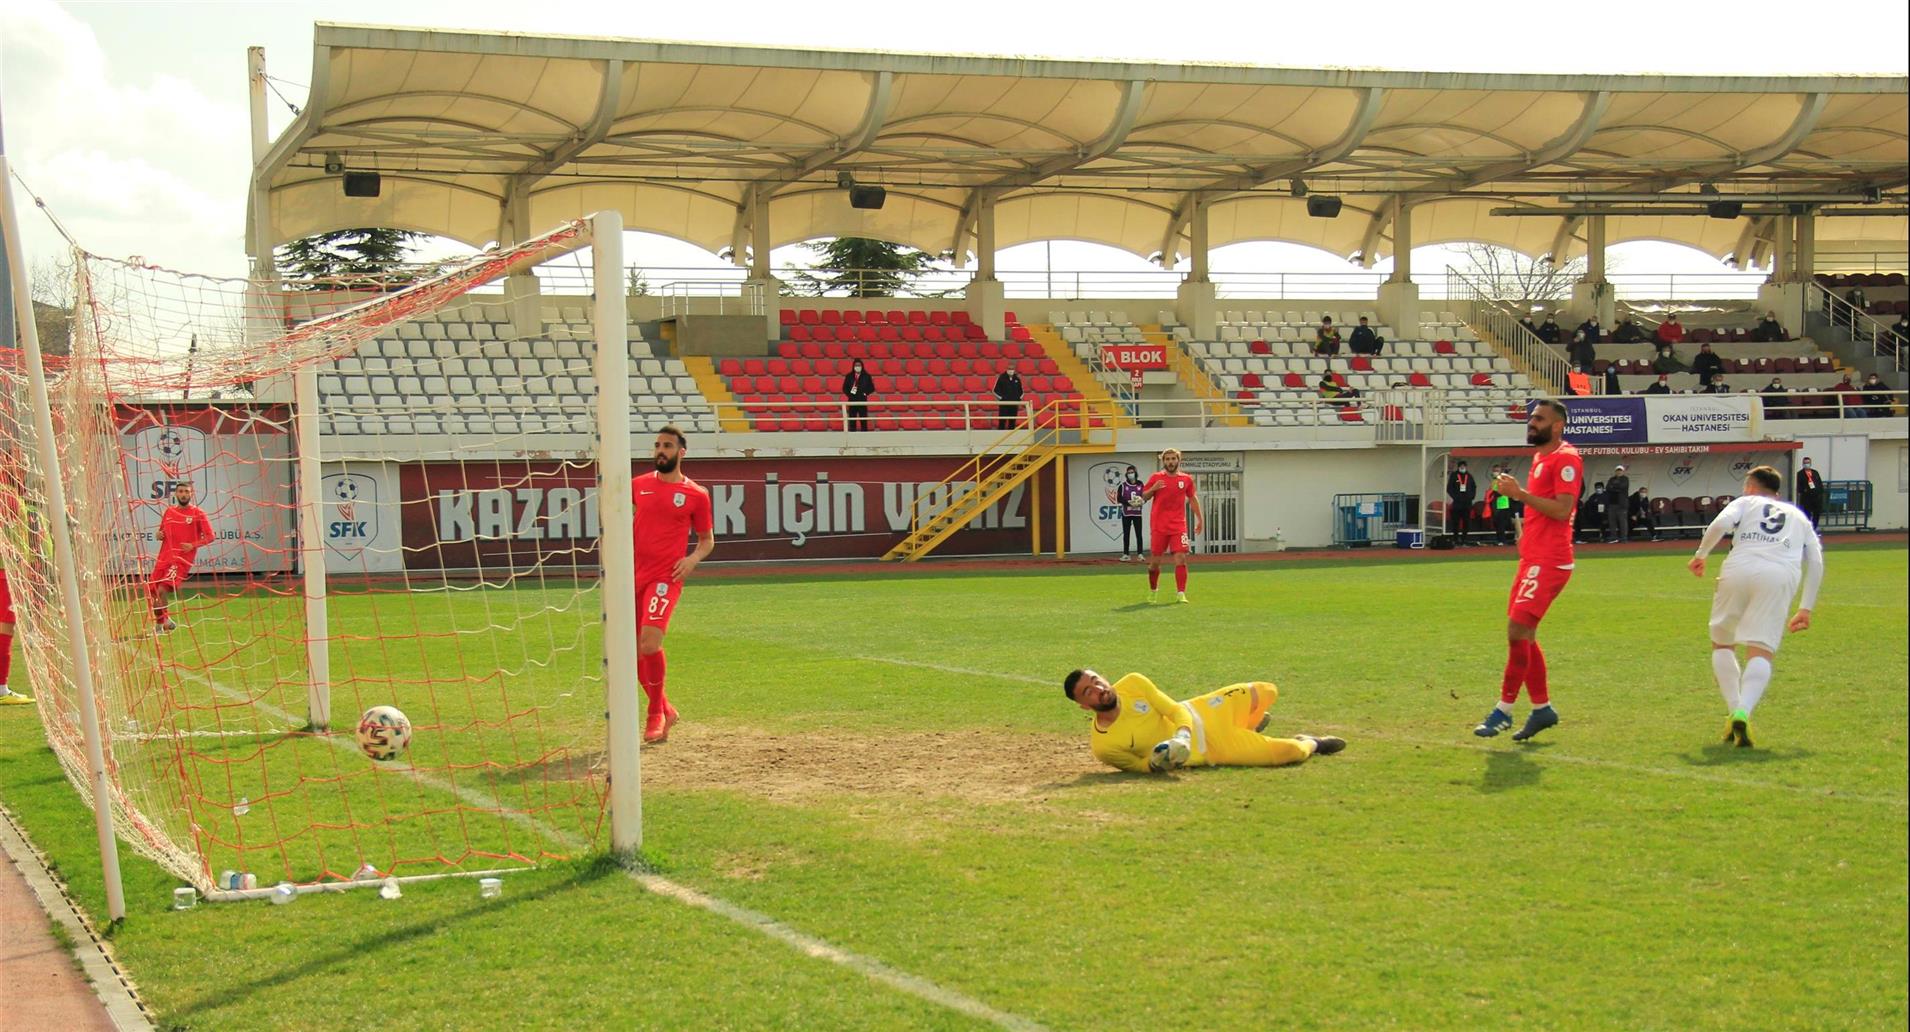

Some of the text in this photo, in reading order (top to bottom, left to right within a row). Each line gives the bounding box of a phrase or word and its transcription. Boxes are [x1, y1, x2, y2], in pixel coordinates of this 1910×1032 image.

[1105, 351, 1162, 363] A BLOK
[1662, 413, 1750, 422] OKAN ÜNİVERSİTESİ
[1681, 423, 1730, 432] HASTANESİ
[1593, 447, 1620, 455] FUTBOL
[1655, 446, 1664, 454] EV
[1688, 445, 1709, 453] TAKIM
[1672, 466, 1693, 475] SFK
[1760, 503, 1785, 534] 9
[329, 521, 368, 538] SFK
[1519, 579, 1538, 599] 72
[648, 596, 669, 615] 87
